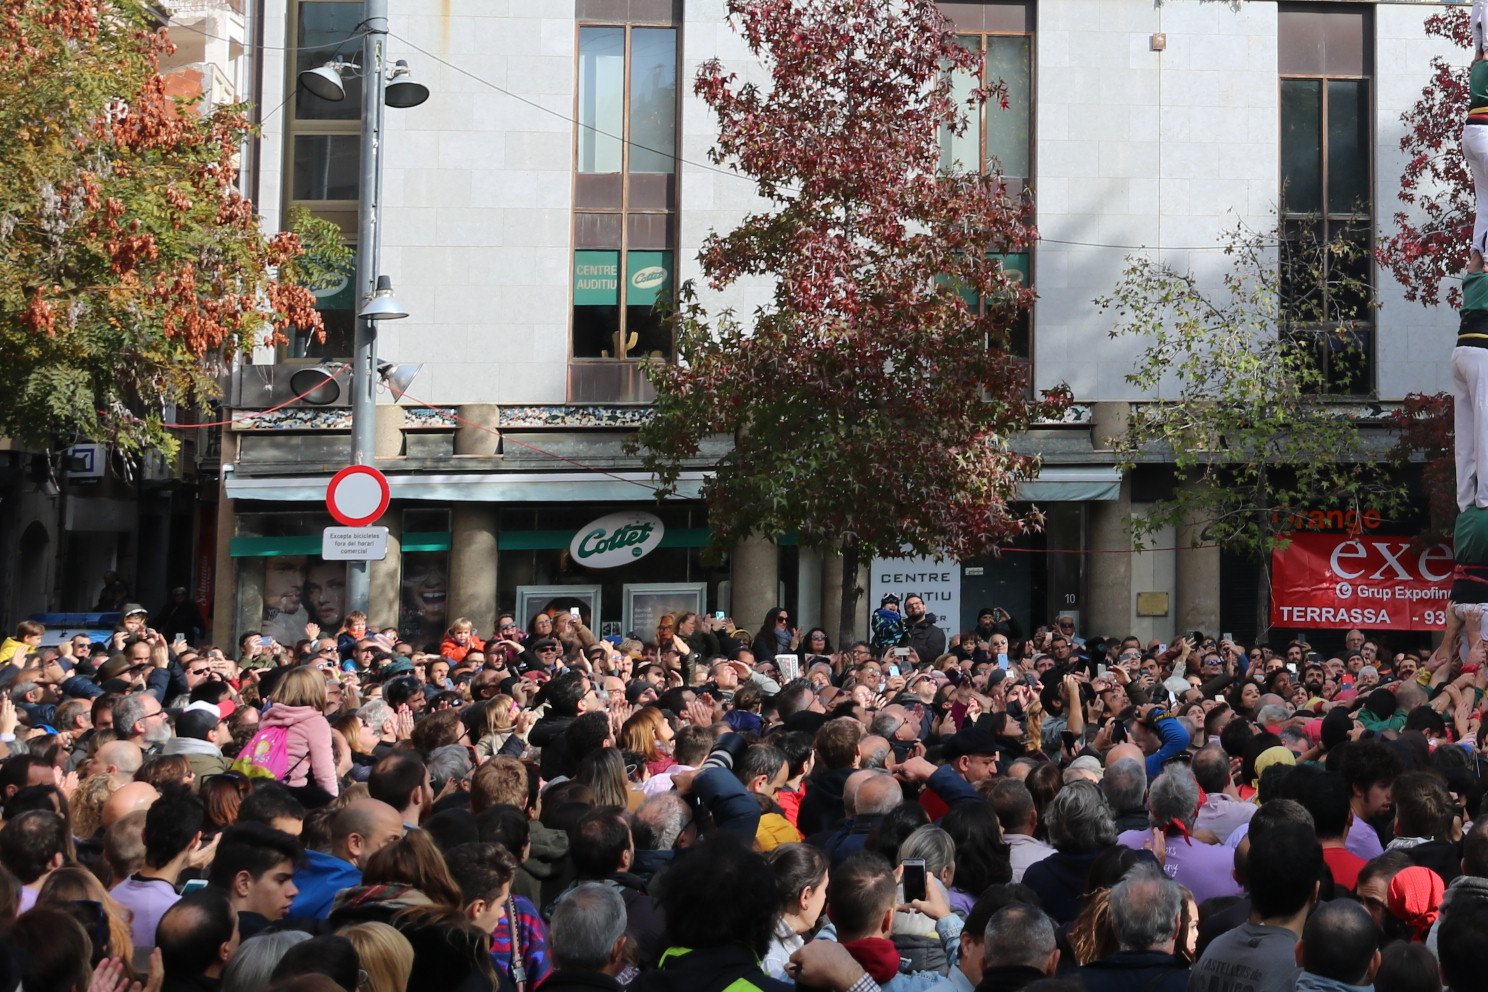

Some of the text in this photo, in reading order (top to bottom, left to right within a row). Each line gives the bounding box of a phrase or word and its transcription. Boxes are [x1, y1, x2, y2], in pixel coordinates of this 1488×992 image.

[576, 264, 617, 276] CENTRE
[576, 279, 617, 290] AUDITIU
[577, 520, 655, 558] Cottet
[881, 572, 951, 584] CENTRE
[1064, 593, 1076, 604] 10
[1357, 586, 1392, 601] Grup
[1280, 606, 1391, 624] TERRASSA
